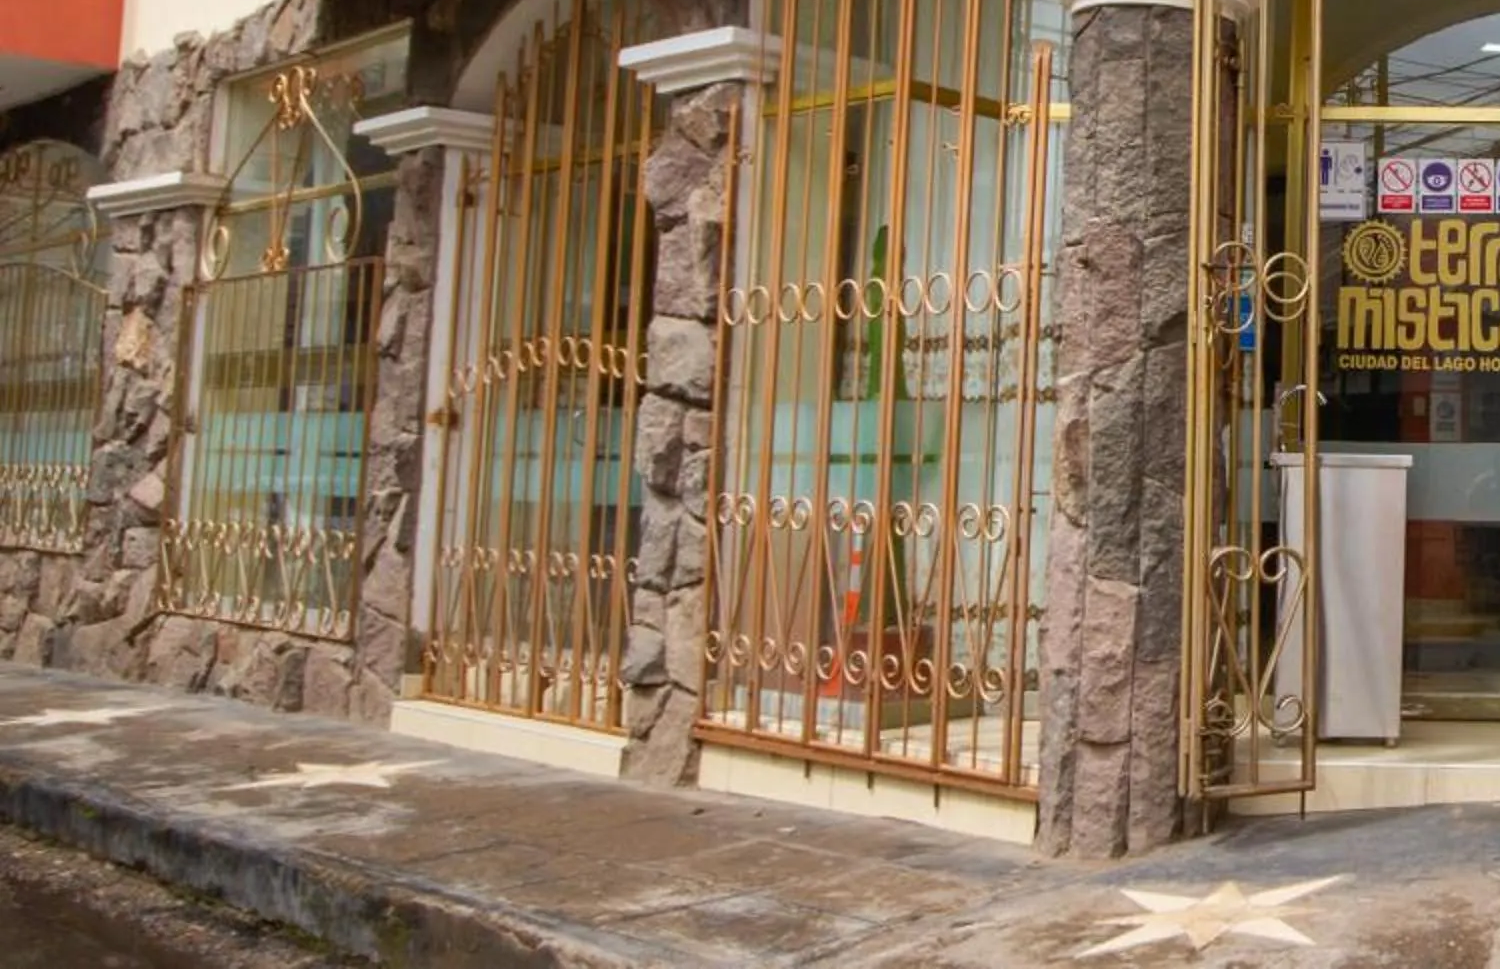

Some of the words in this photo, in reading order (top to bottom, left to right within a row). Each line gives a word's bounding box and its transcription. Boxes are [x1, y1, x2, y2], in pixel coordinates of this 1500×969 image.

[1338, 354, 1399, 371] CIUDAD
[1401, 355, 1431, 370] DEL
[1434, 356, 1476, 371] LAGO
